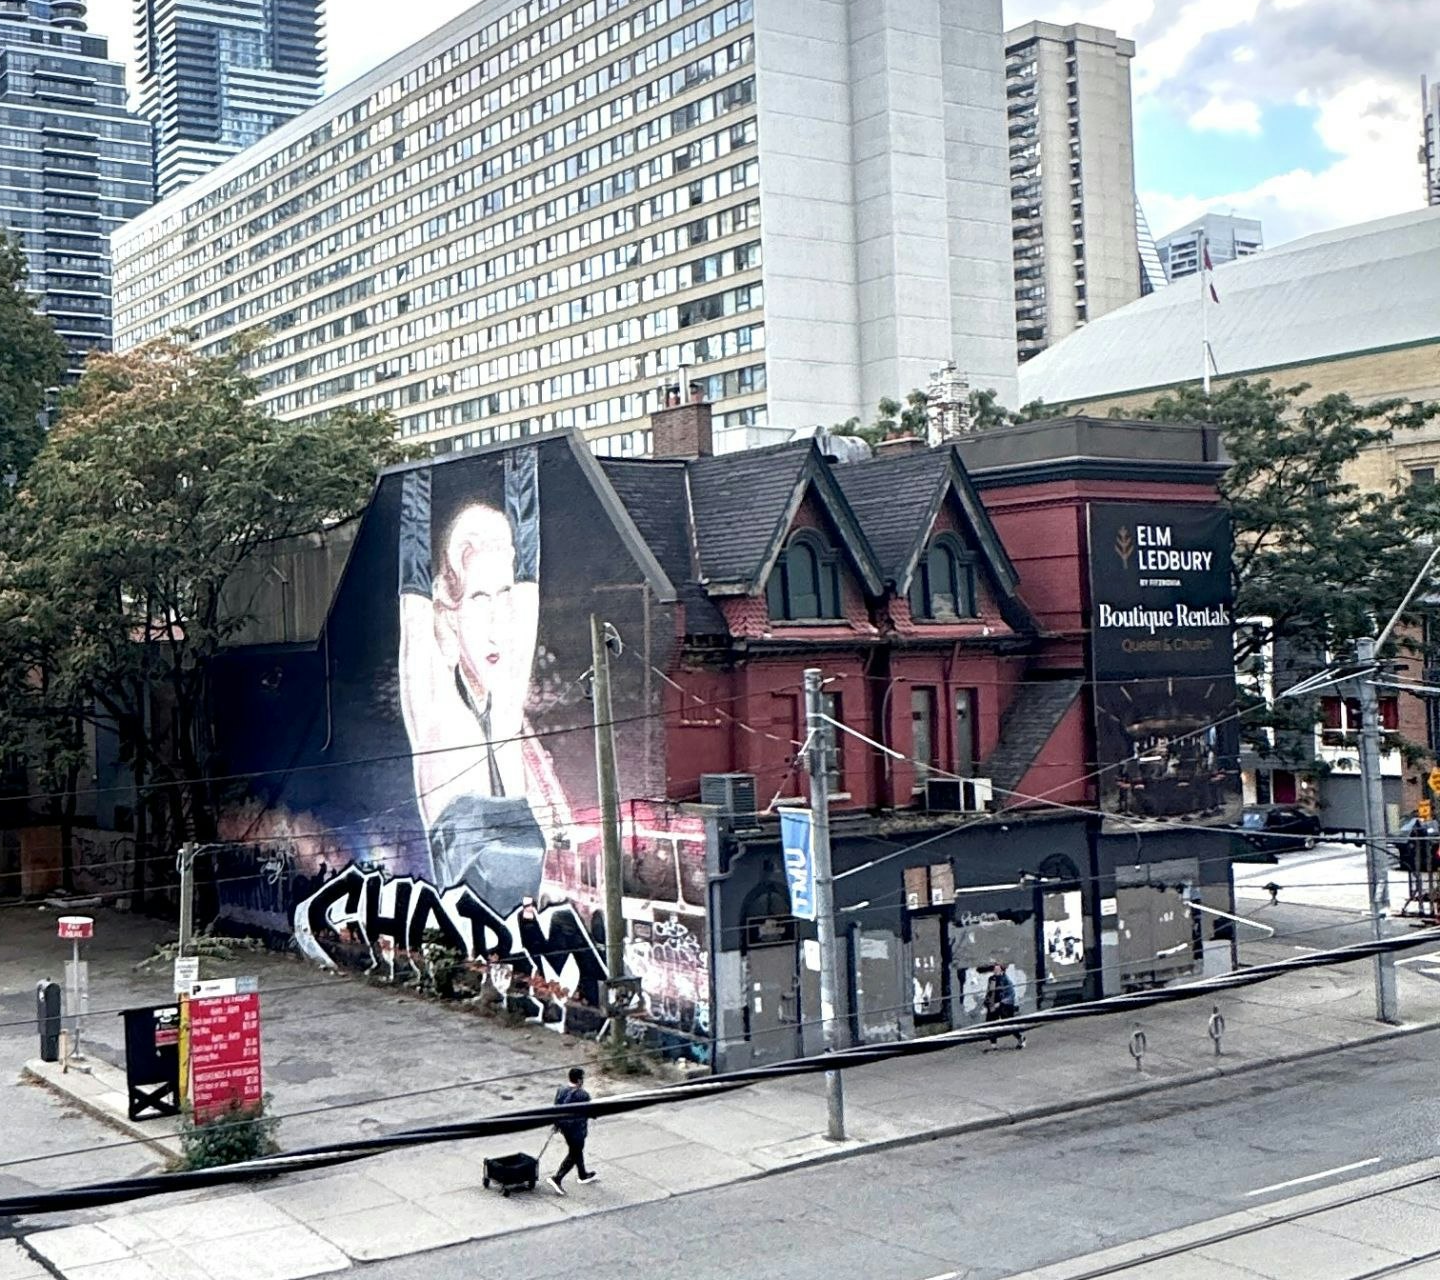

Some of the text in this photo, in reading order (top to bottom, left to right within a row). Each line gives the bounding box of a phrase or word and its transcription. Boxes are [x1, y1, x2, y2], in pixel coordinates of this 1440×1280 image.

[1137, 526, 1171, 546] ELM
[1138, 550, 1212, 570] LEDBURY
[1099, 604, 1230, 634] Boutique Rentals
[784, 847, 808, 912] TMU
